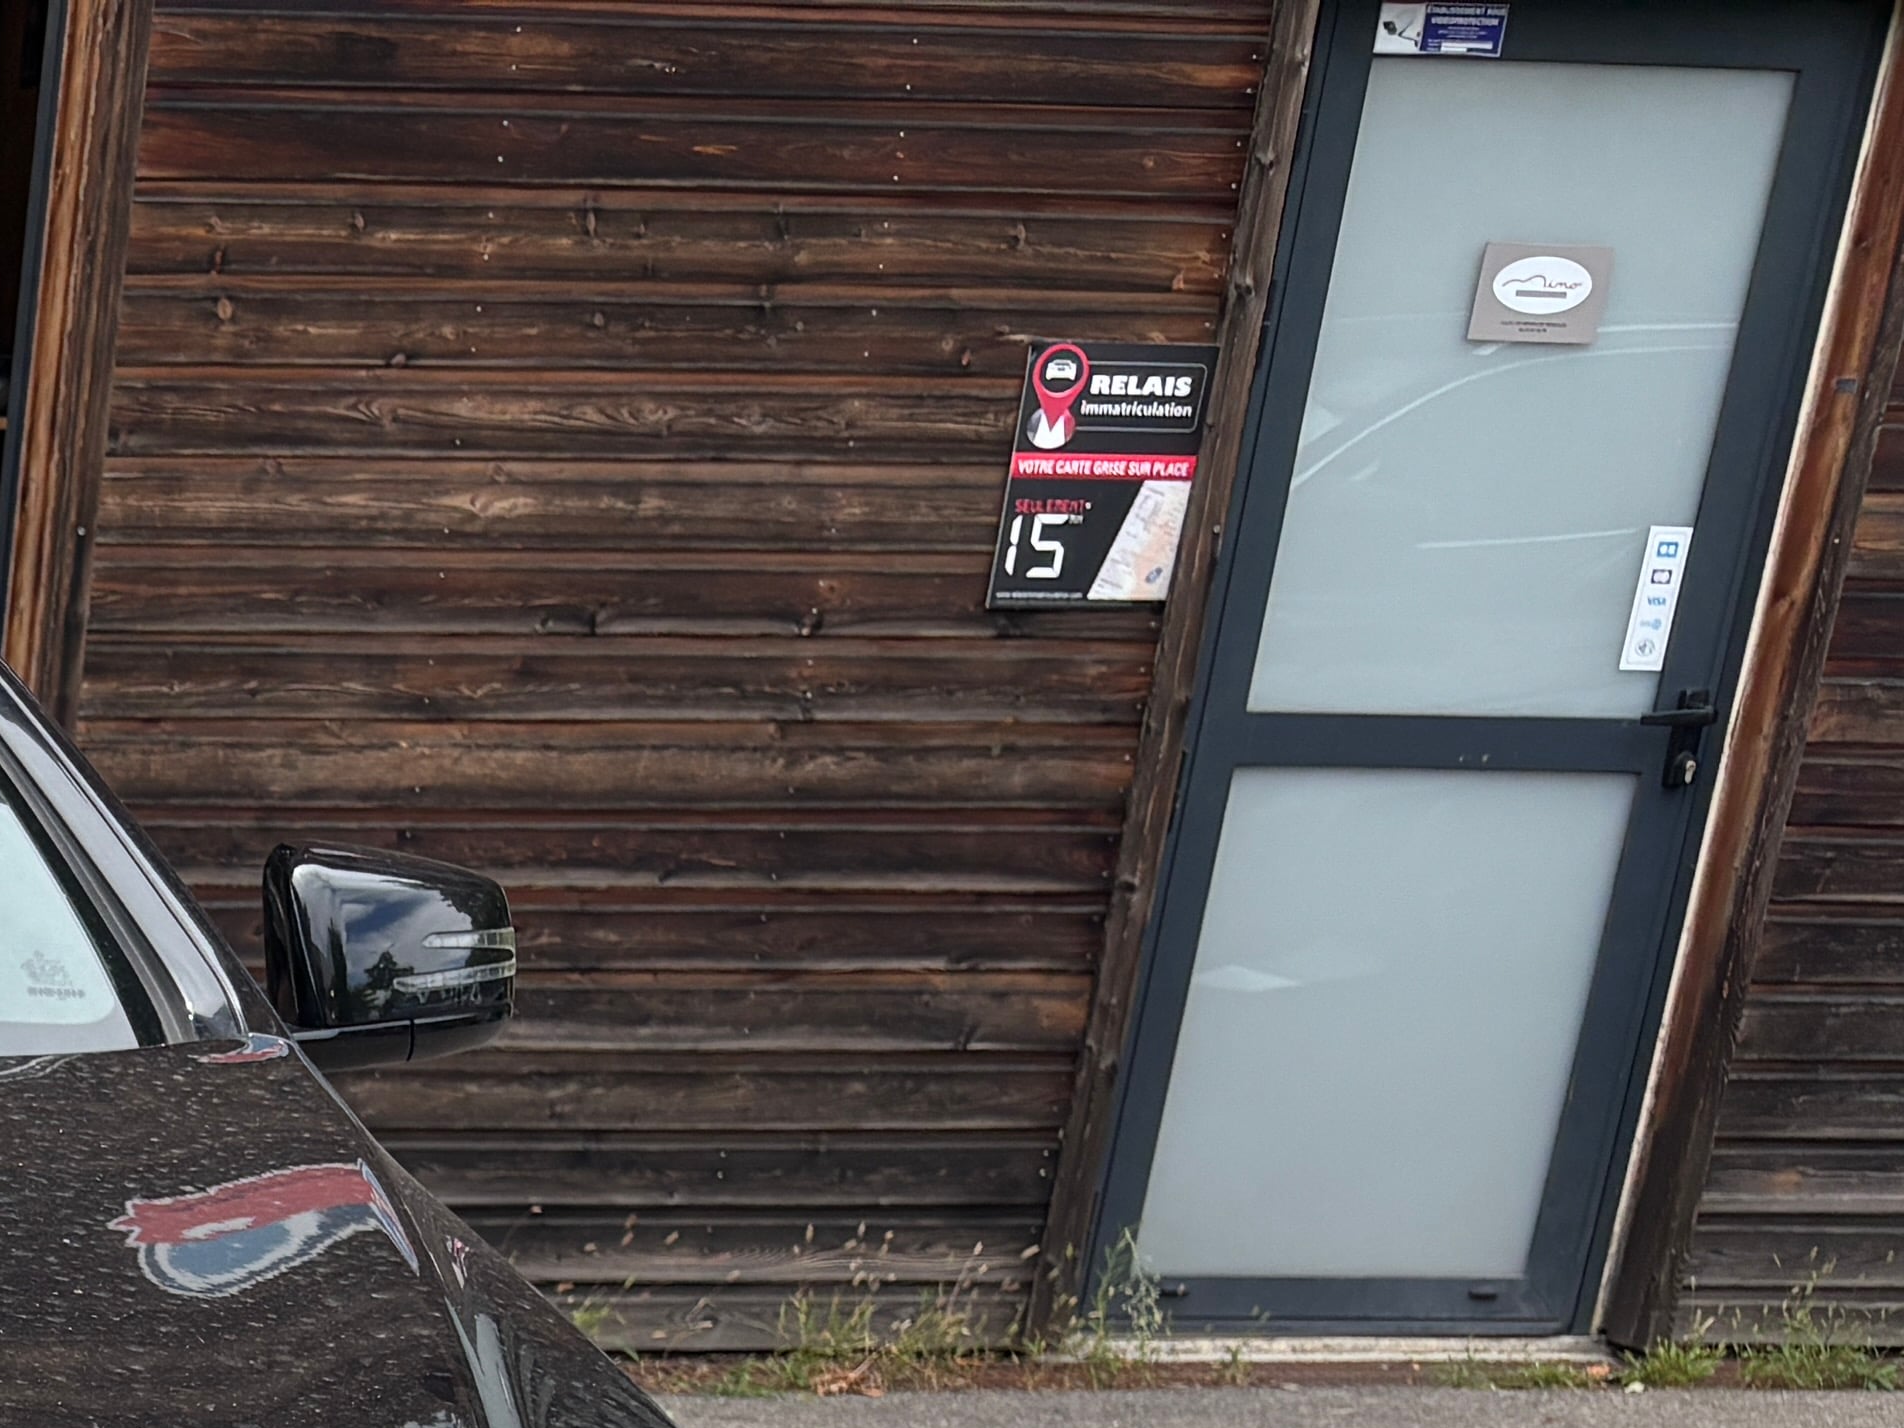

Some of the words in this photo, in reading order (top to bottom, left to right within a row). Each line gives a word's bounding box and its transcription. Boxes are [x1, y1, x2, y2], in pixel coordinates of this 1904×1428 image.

[1090, 374, 1192, 397] RELAIS
[1018, 459, 1055, 475] VOTRE
[1055, 460, 1092, 475] CARTE
[1093, 460, 1128, 476] GRISE
[1128, 461, 1152, 476] SUR
[1152, 462, 1190, 477] PLACE
[1004, 513, 1065, 579] 15
